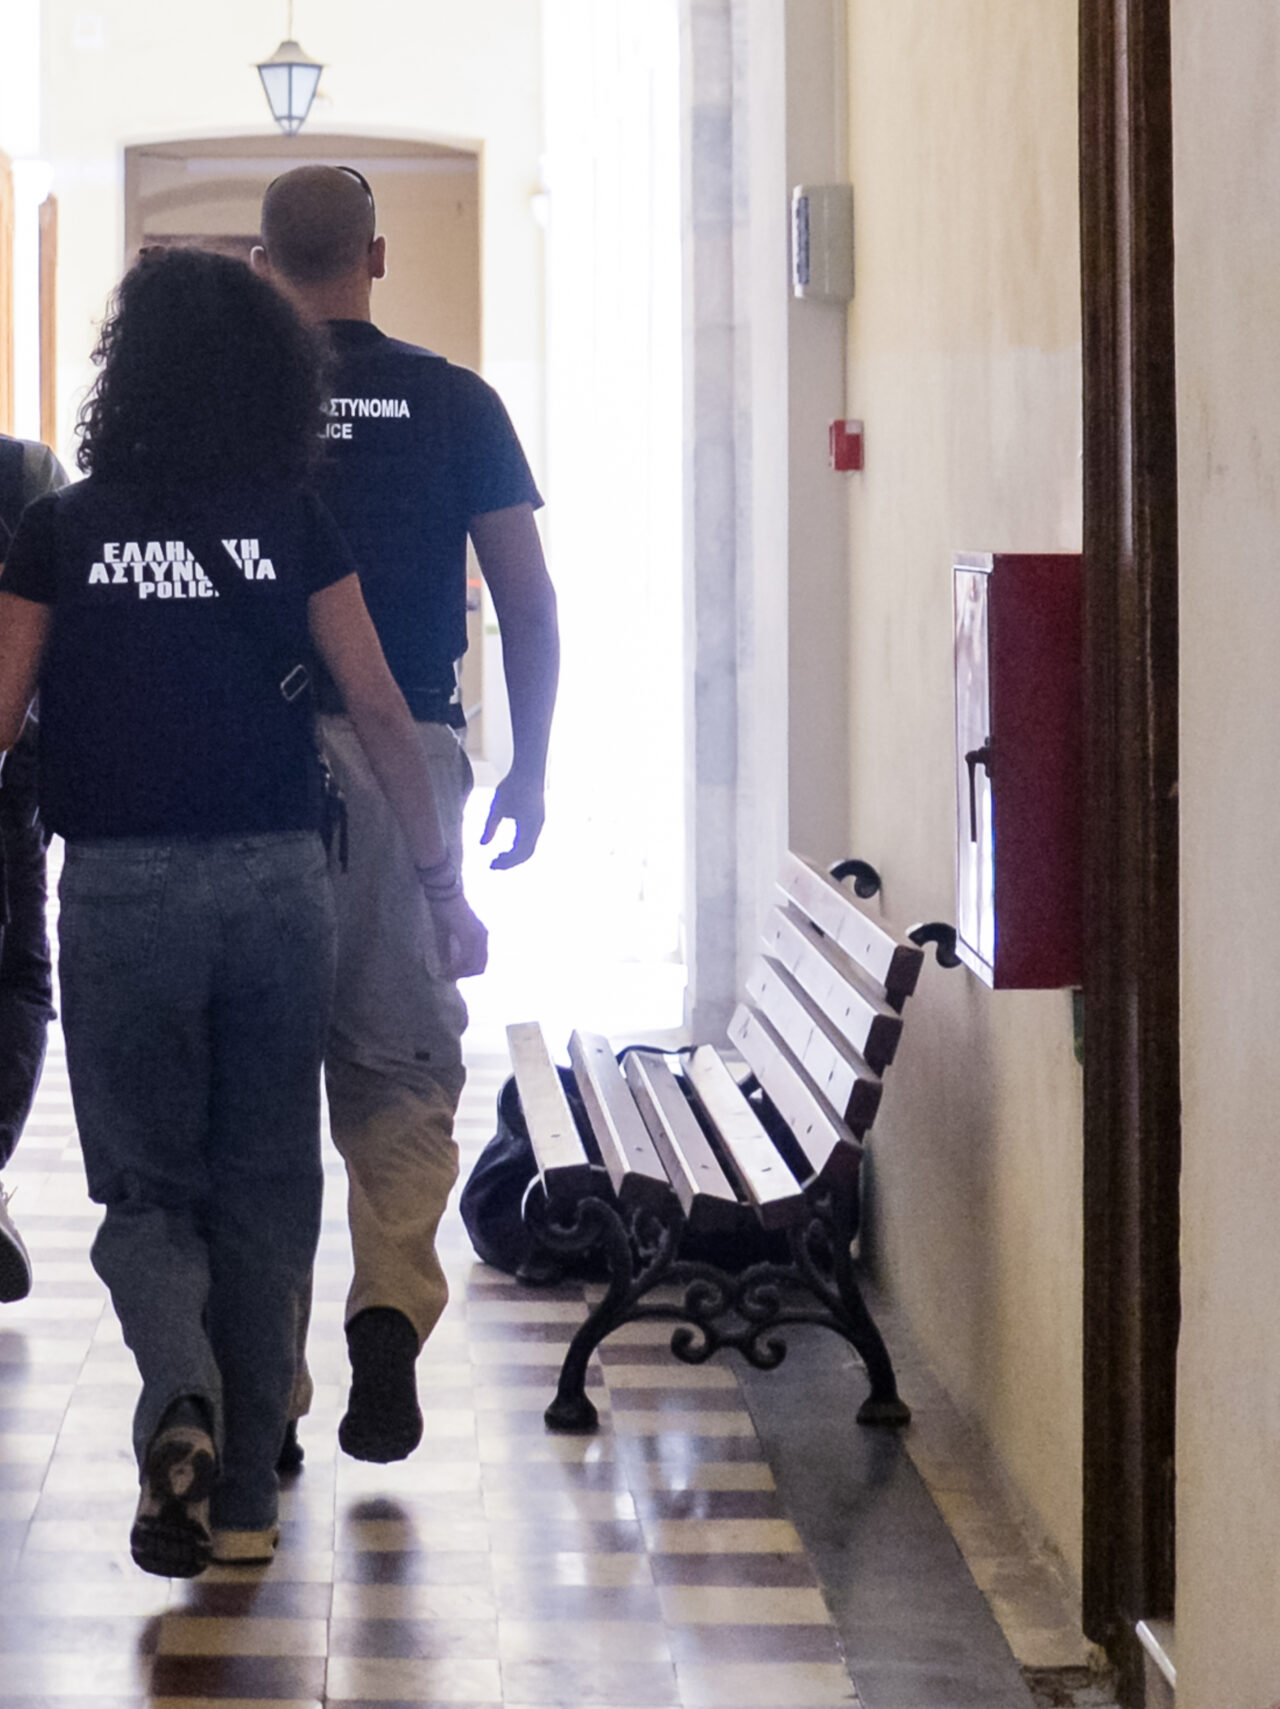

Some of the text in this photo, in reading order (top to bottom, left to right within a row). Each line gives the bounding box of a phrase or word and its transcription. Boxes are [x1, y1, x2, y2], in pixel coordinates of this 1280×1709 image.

[103, 539, 260, 564] ΕΛΛΗΚΗ
[87, 558, 277, 585] ΑΣΤΥΝΙΑ
[138, 580, 220, 600] POLIC
